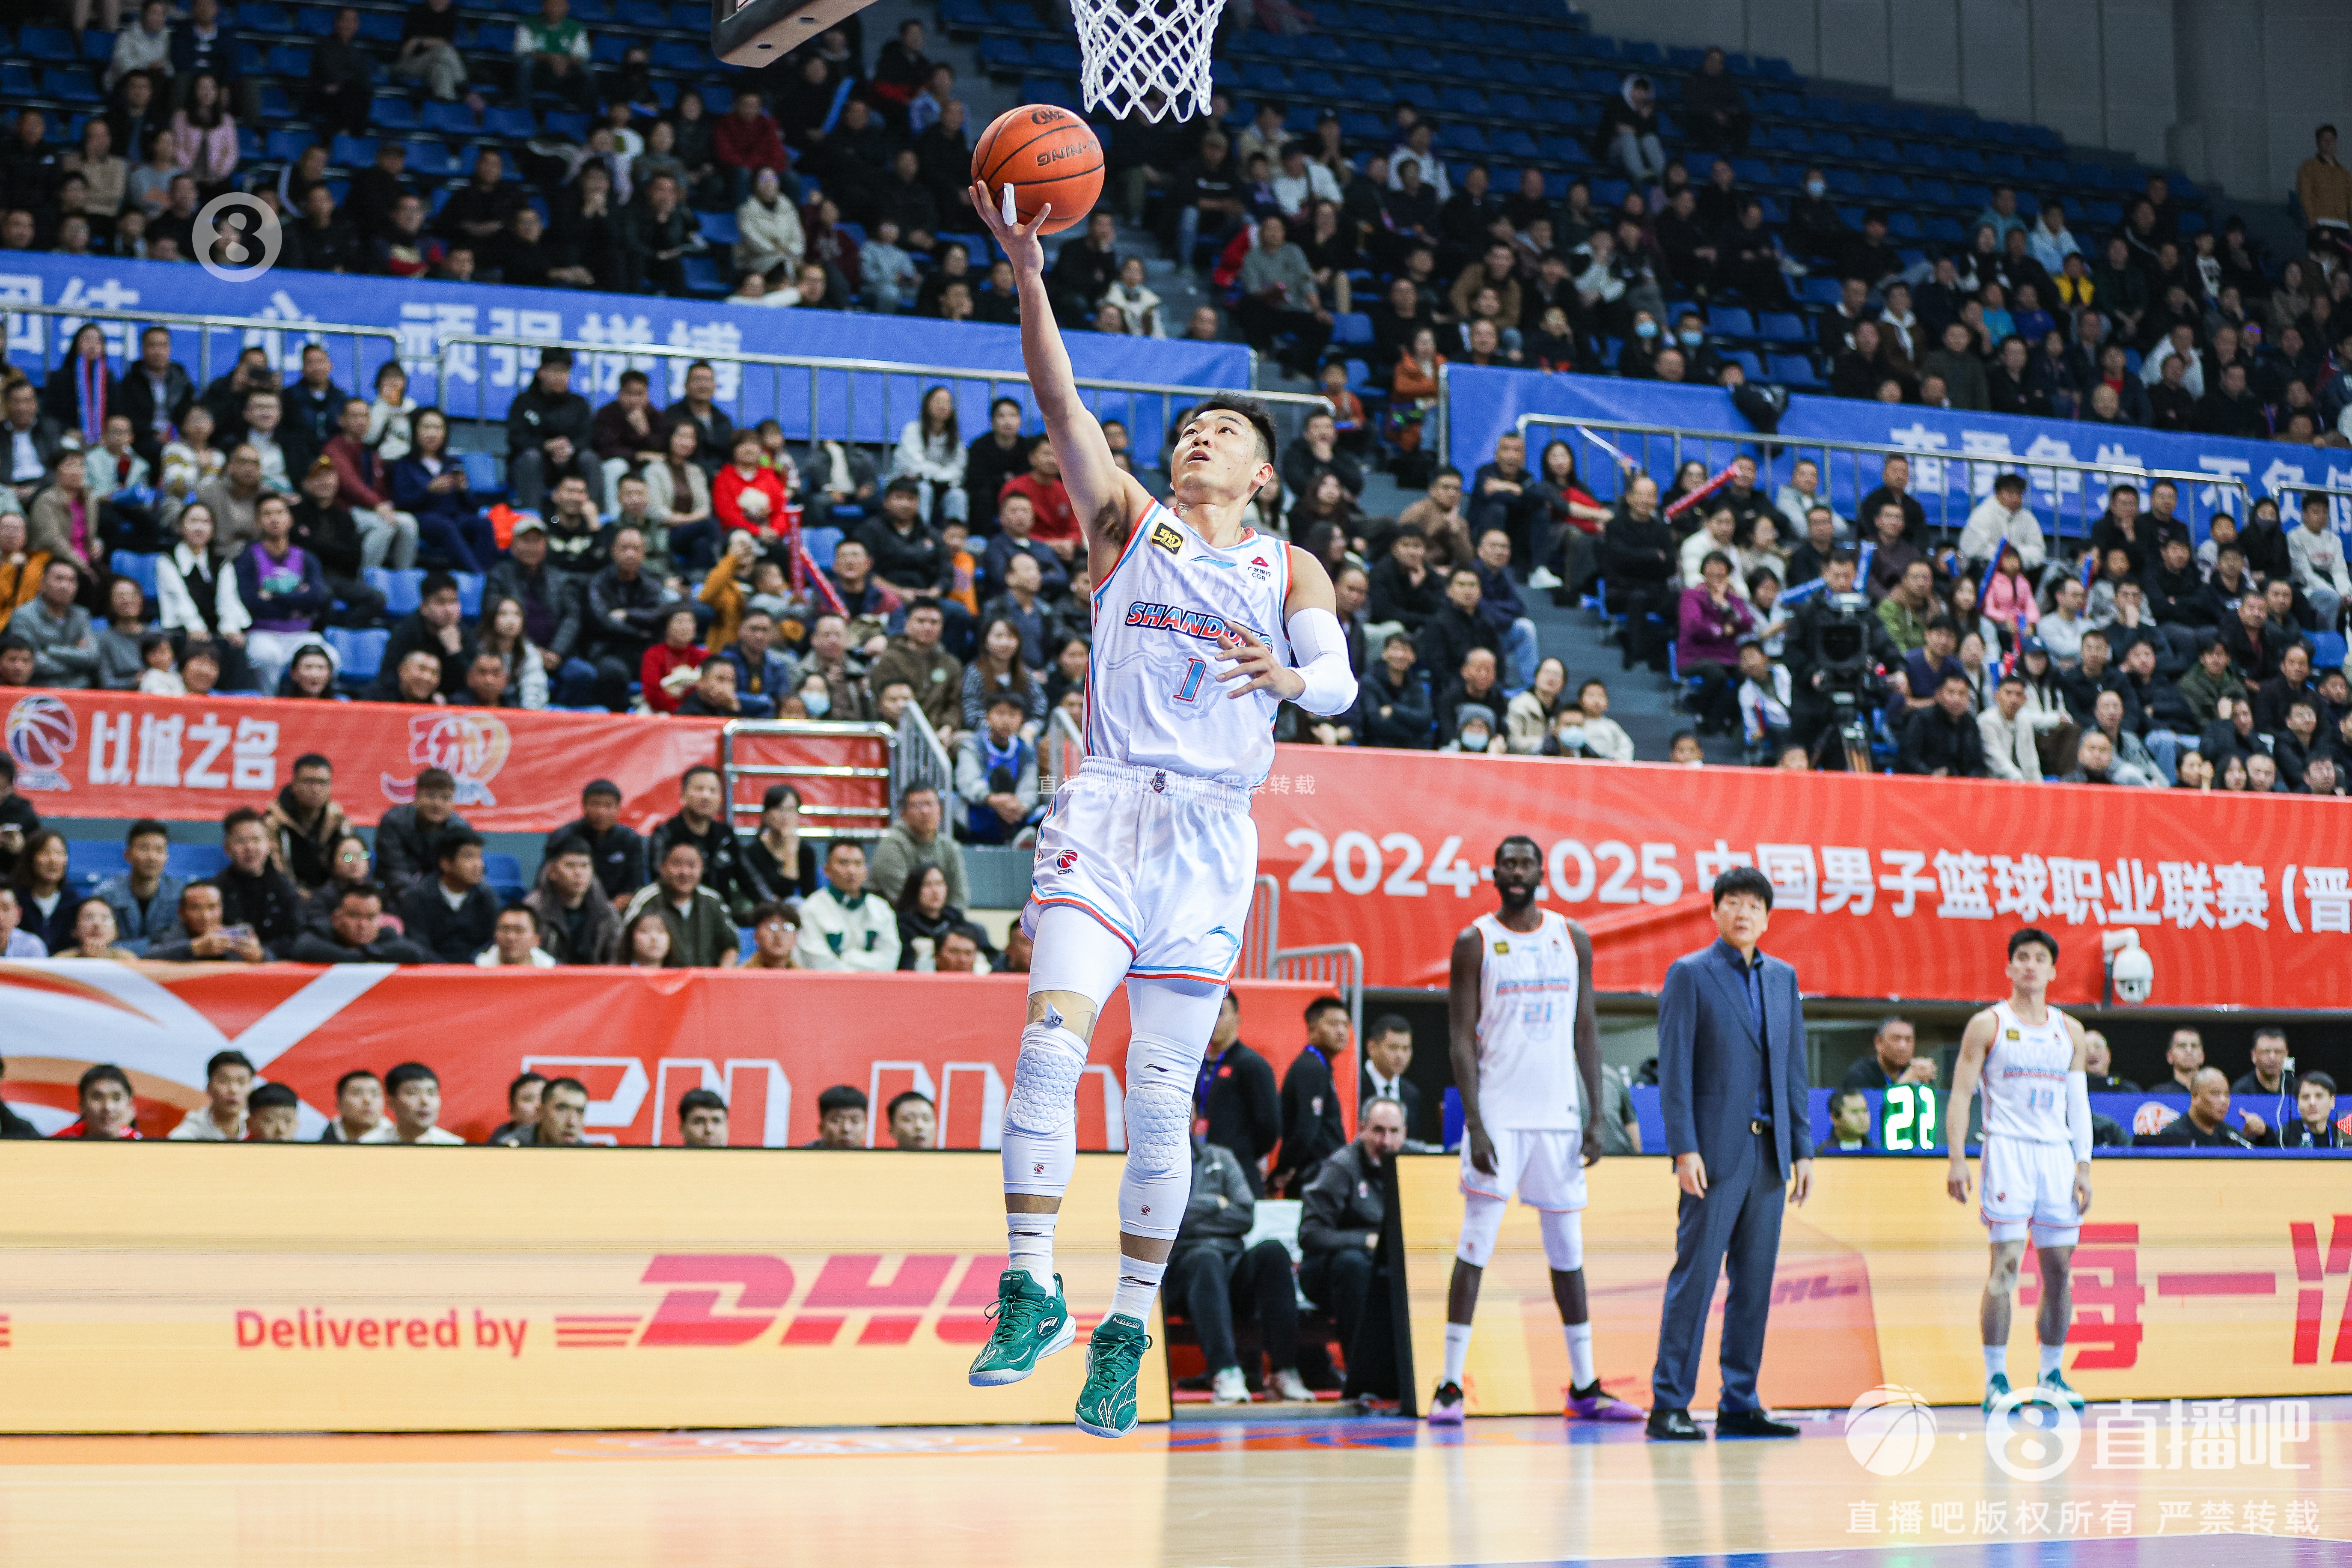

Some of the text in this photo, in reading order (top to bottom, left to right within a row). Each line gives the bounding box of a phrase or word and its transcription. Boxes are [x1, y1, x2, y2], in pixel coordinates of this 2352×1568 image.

[1252, 572, 1266, 581] CGB
[1125, 601, 1273, 654] SHANDOG
[1173, 658, 1206, 702] 1
[88, 711, 279, 791] 以城之名
[1284, 827, 1683, 905] 2024-025
[1523, 1002, 1552, 1024] 21
[235, 1309, 458, 1348] Delivered
[474, 1309, 529, 1358] by
